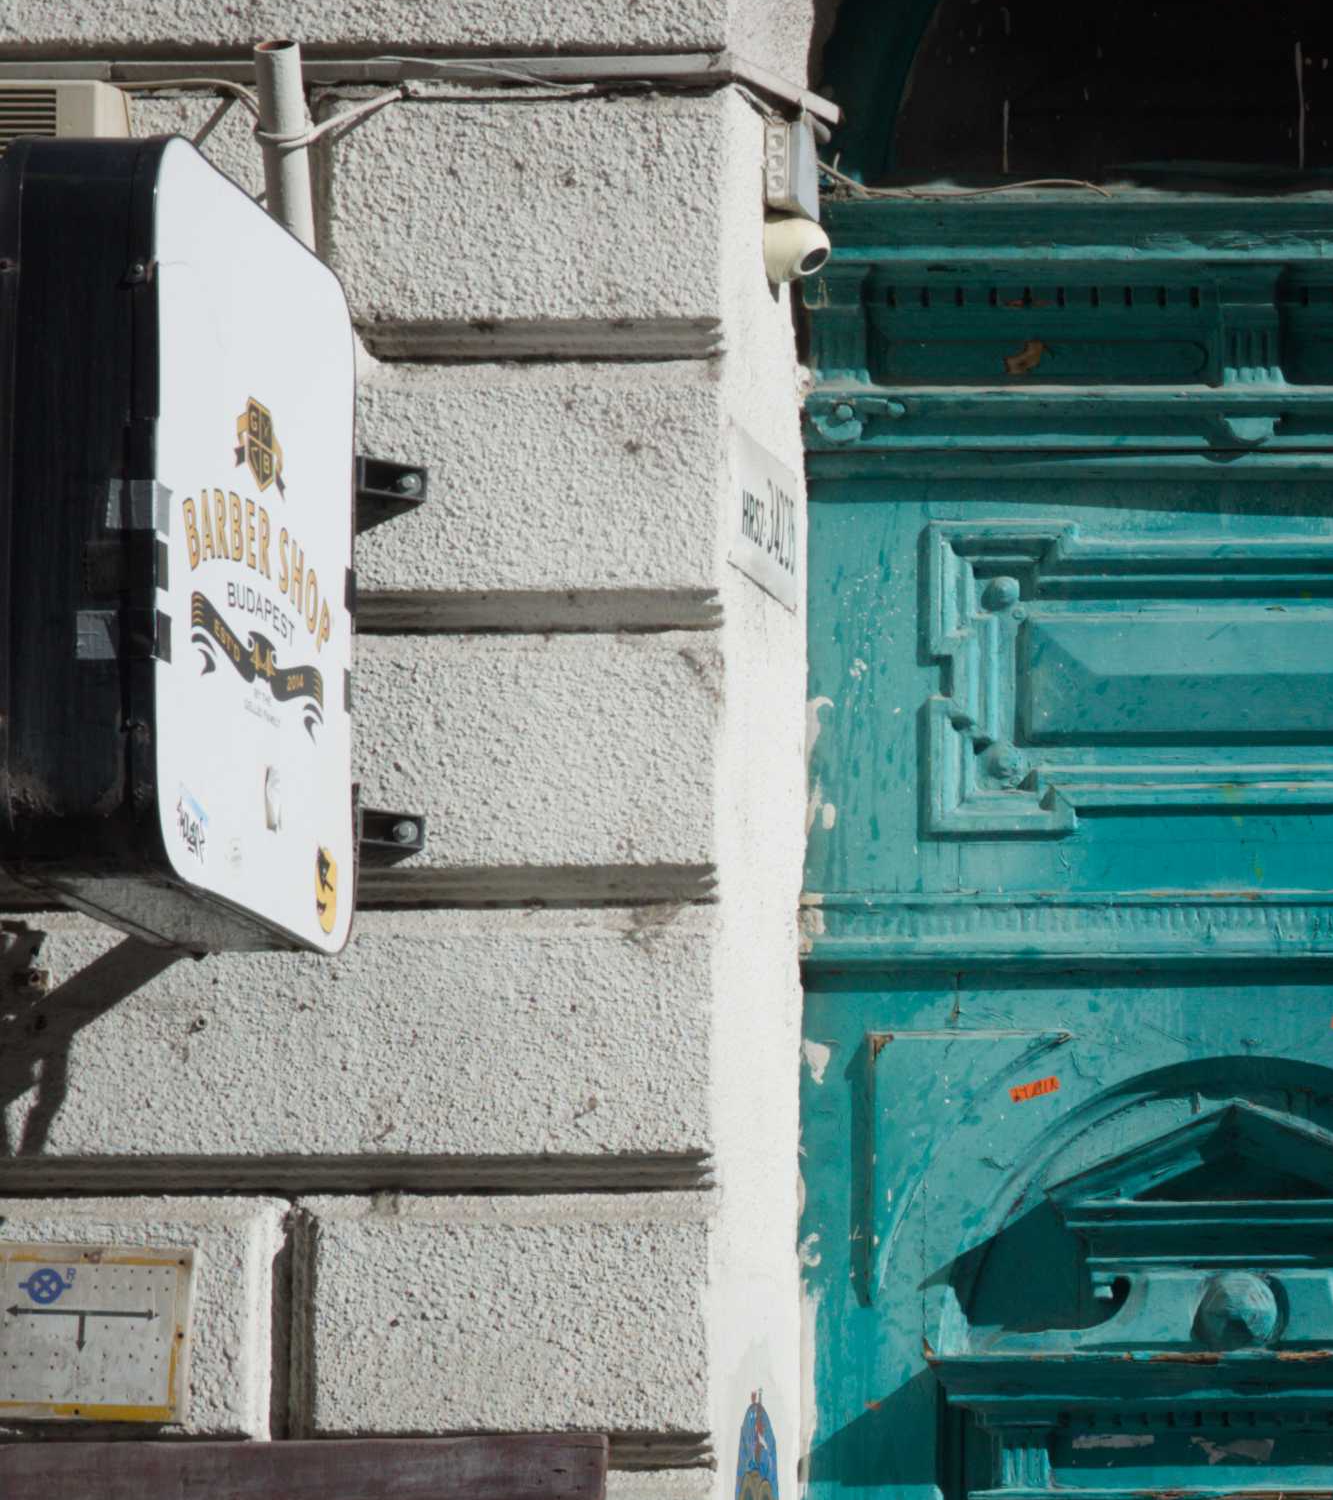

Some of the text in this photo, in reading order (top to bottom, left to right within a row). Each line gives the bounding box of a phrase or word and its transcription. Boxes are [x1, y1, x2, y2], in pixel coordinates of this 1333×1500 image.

[182, 487, 332, 653] BARBER SHOP
[227, 581, 296, 646] BUDAPEST
